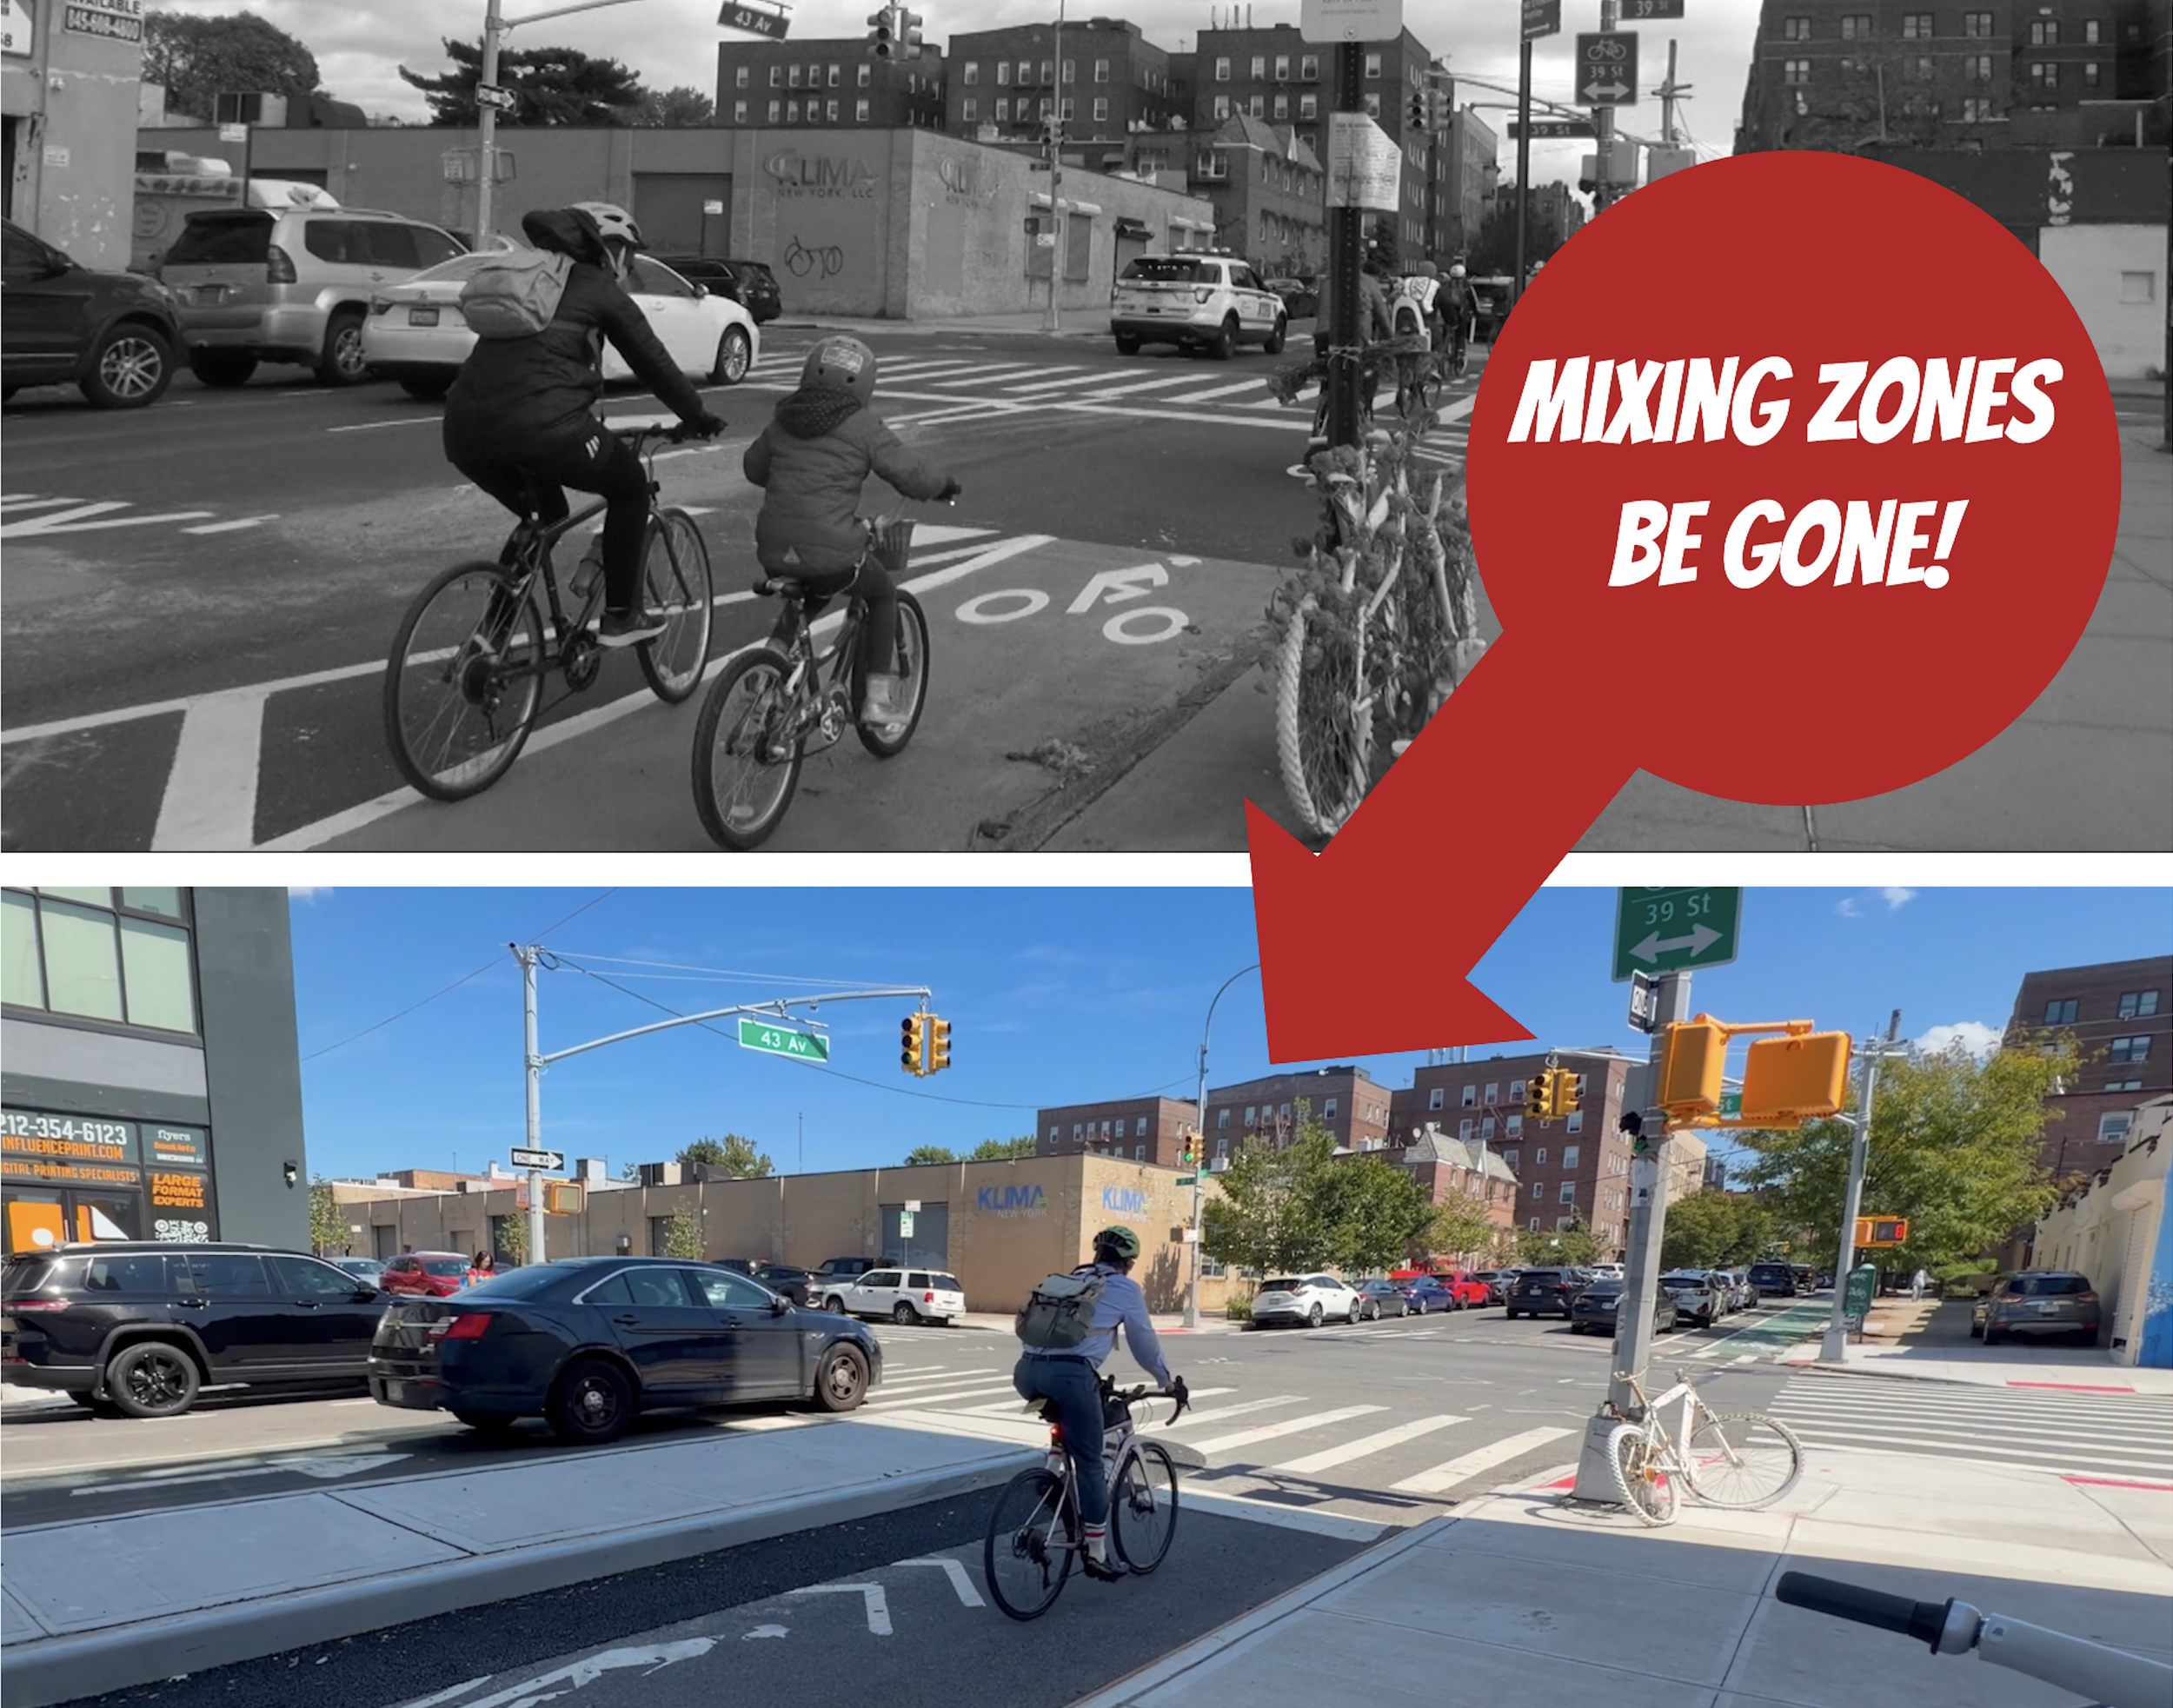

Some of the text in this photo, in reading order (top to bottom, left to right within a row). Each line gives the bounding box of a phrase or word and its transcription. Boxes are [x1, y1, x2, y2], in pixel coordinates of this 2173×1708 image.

[68, 0, 141, 14] LABLE
[1635, 0, 1652, 17] 39
[734, 10, 772, 32] 43 Av
[1590, 66, 1624, 78] 39 St
[1556, 125, 1571, 135] St
[1645, 893, 1711, 925] 39 St
[761, 1031, 807, 1053] 43 Av
[157, 1129, 191, 1141] flyers
[3, 1136, 123, 1160] INFLUENCEPRINT.COM
[33, 1165, 78, 1179] PRINTING
[79, 1168, 136, 1182] SPECIALISTS
[153, 1173, 202, 1187] LARGE
[152, 1185, 203, 1197] FORMAT
[979, 1185, 1048, 1210] KLIMA
[153, 1196, 204, 1208] EXPERTS
[997, 1208, 1047, 1218] NEW YORK
